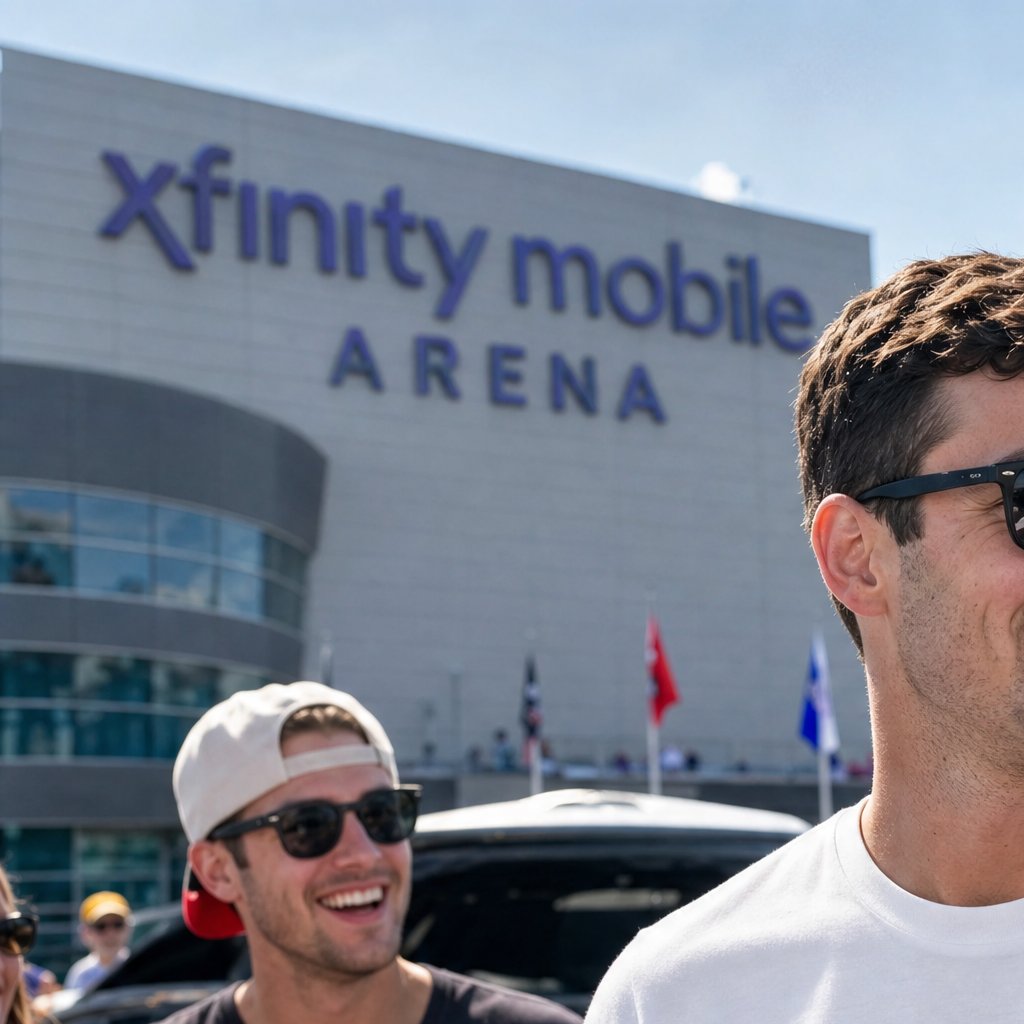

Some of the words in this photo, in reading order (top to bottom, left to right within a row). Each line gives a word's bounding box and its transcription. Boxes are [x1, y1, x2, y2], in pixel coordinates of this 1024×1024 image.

[100, 145, 487, 319] xfinity
[511, 235, 813, 351] mobile
[331, 327, 667, 423] ARENA
